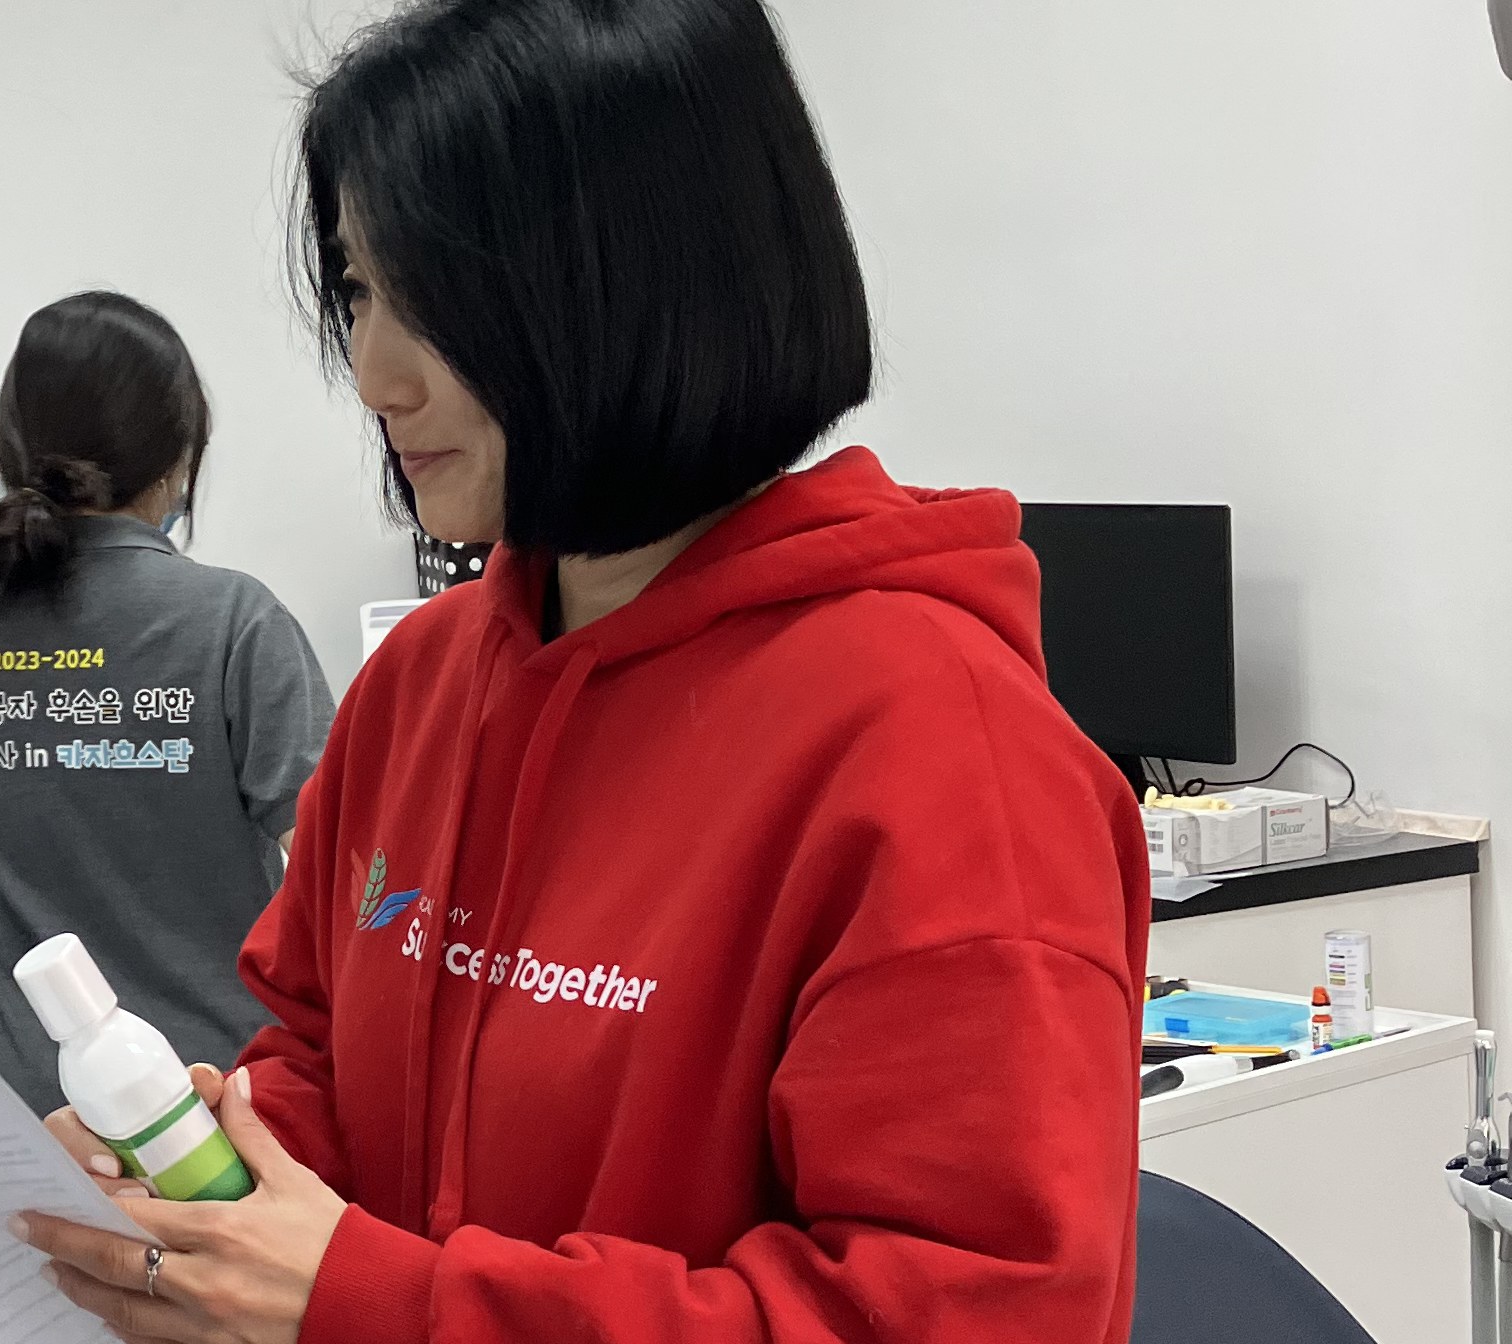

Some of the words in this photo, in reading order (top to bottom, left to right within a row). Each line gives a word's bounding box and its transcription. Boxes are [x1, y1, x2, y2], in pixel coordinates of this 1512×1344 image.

[46, 688, 123, 724] 후손을
[133, 688, 194, 723] 위한
[25, 742, 48, 768] in
[56, 737, 194, 773] 카자흐스탄
[509, 947, 658, 1013] Together
